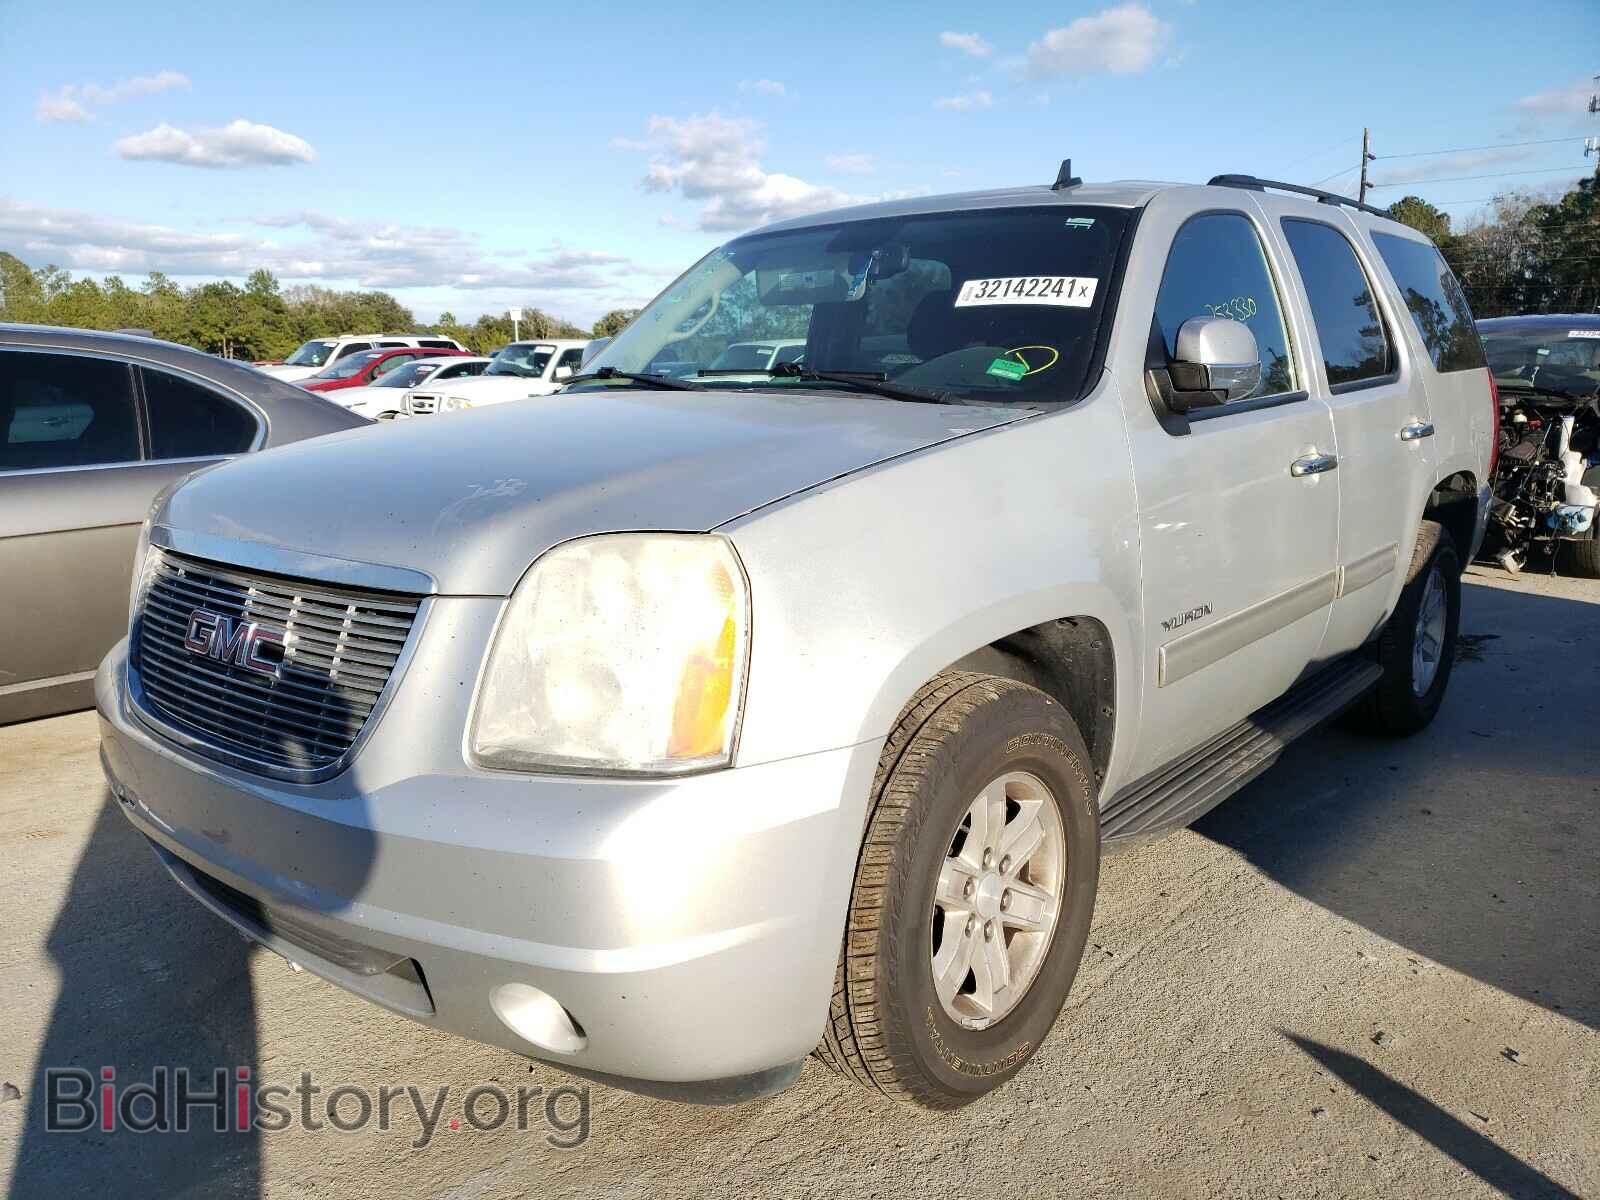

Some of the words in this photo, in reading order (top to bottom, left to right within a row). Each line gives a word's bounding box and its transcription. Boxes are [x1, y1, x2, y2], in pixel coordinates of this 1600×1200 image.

[975, 278, 1077, 299] 32142241
[1160, 602, 1213, 632] YUKON
[184, 609, 288, 681] GMC
